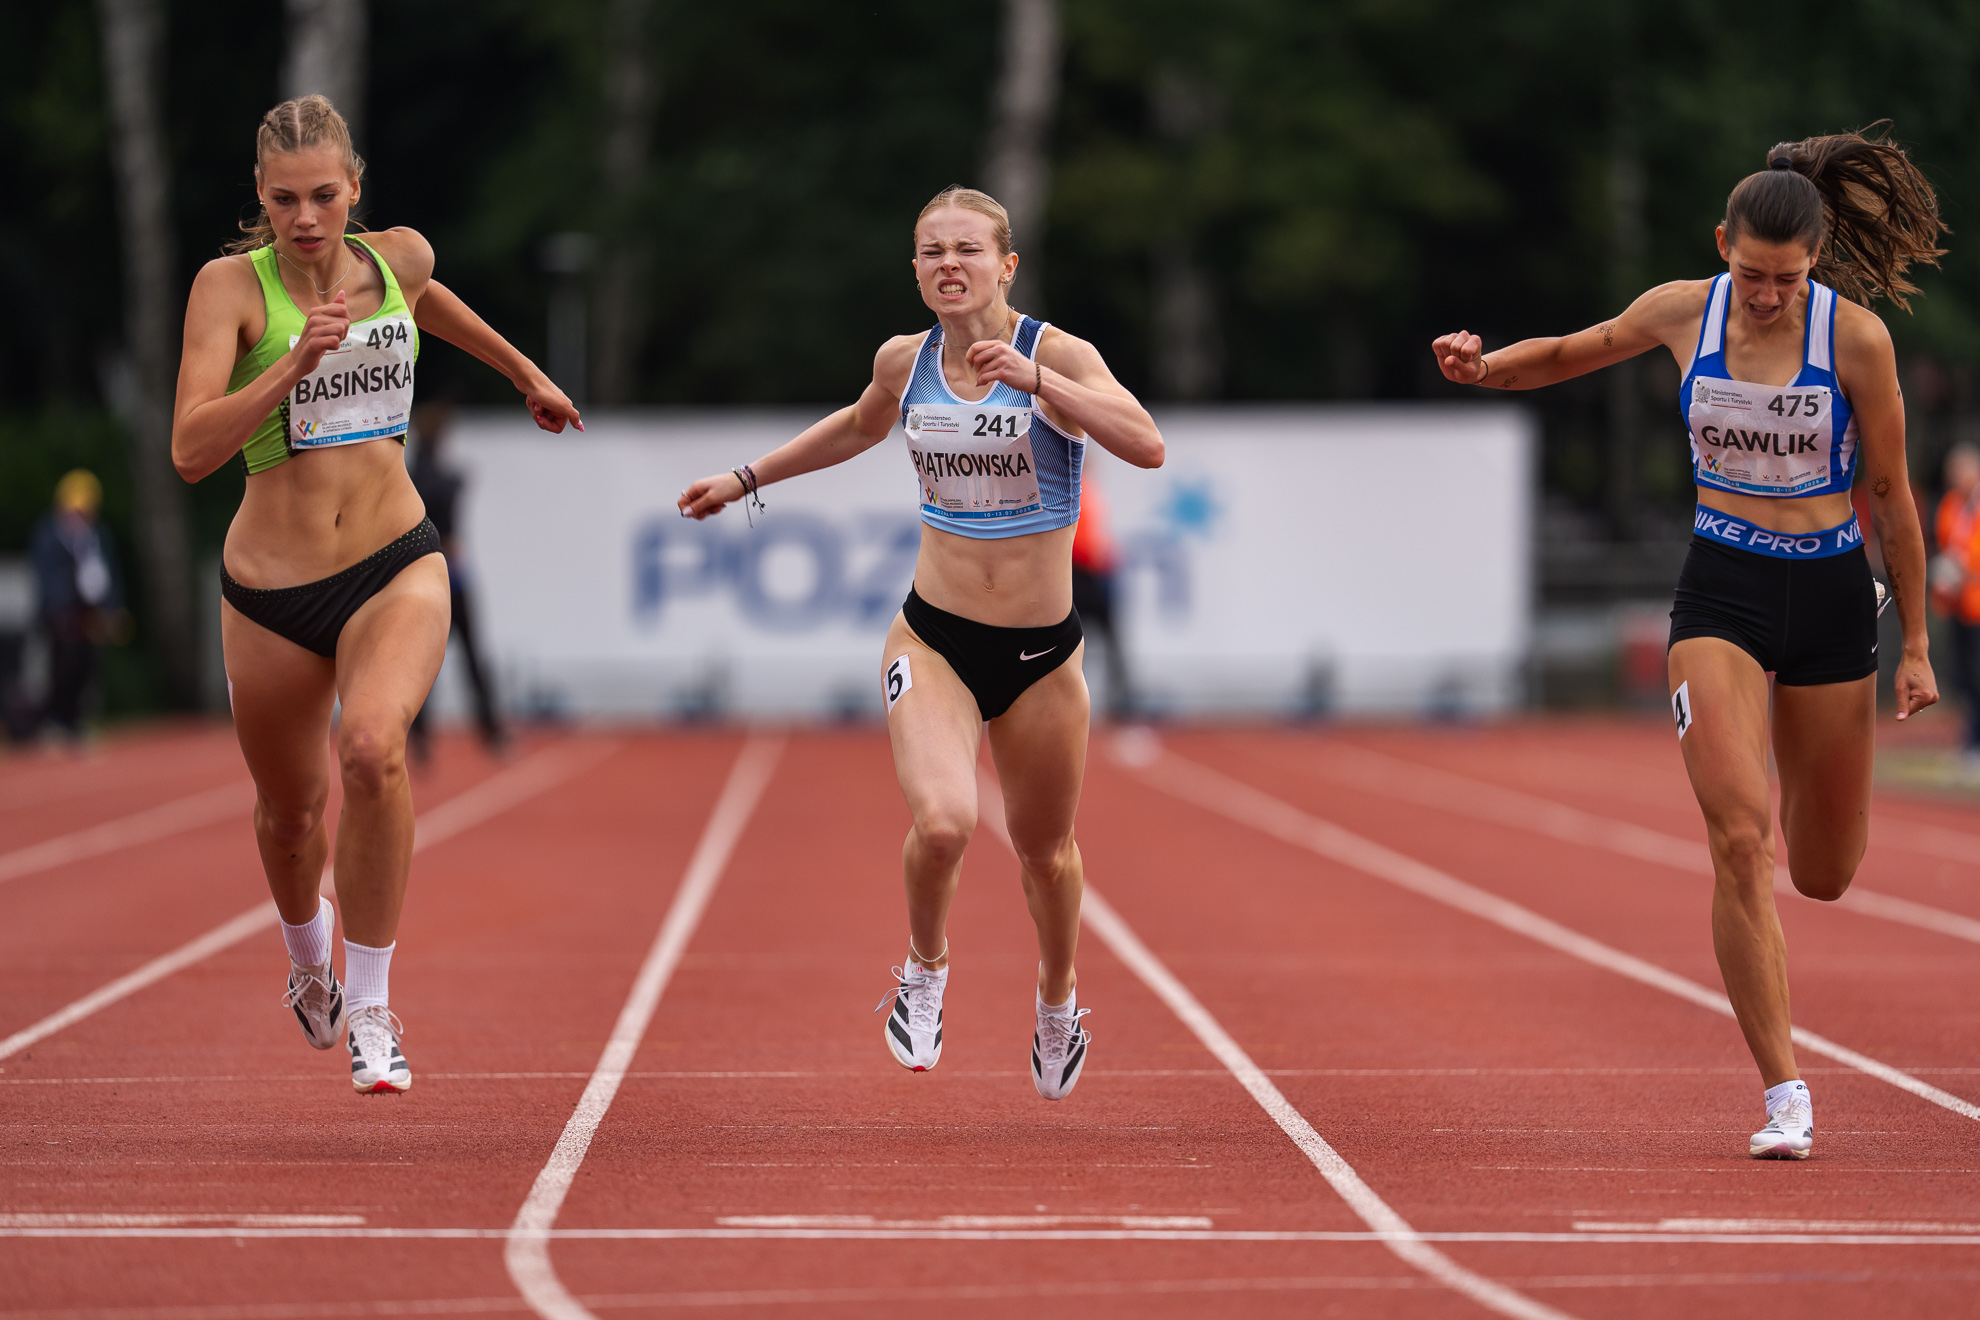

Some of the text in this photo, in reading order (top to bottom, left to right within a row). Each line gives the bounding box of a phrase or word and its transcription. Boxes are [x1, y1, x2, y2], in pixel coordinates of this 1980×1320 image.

[366, 321, 408, 350] 494
[295, 360, 412, 405] BASIŃSKA
[1711, 389, 1743, 398] Ministerstwo
[1710, 395, 1727, 403] Sportu
[1730, 397, 1752, 405] Turystyki
[1767, 394, 1819, 417] 475
[972, 413, 1018, 438] 241
[313, 436, 342, 445] POZNAŃ
[1701, 425, 1819, 457] GAWLIK
[911, 449, 1031, 482] PIĄTKOWSKA
[1715, 476, 1740, 487] POZNAŃ
[934, 508, 954, 517] POZNAŃ
[1694, 511, 1747, 542] NIKE
[1748, 530, 1821, 554] PRO
[888, 660, 903, 702] 5
[1676, 691, 1686, 731] 4
